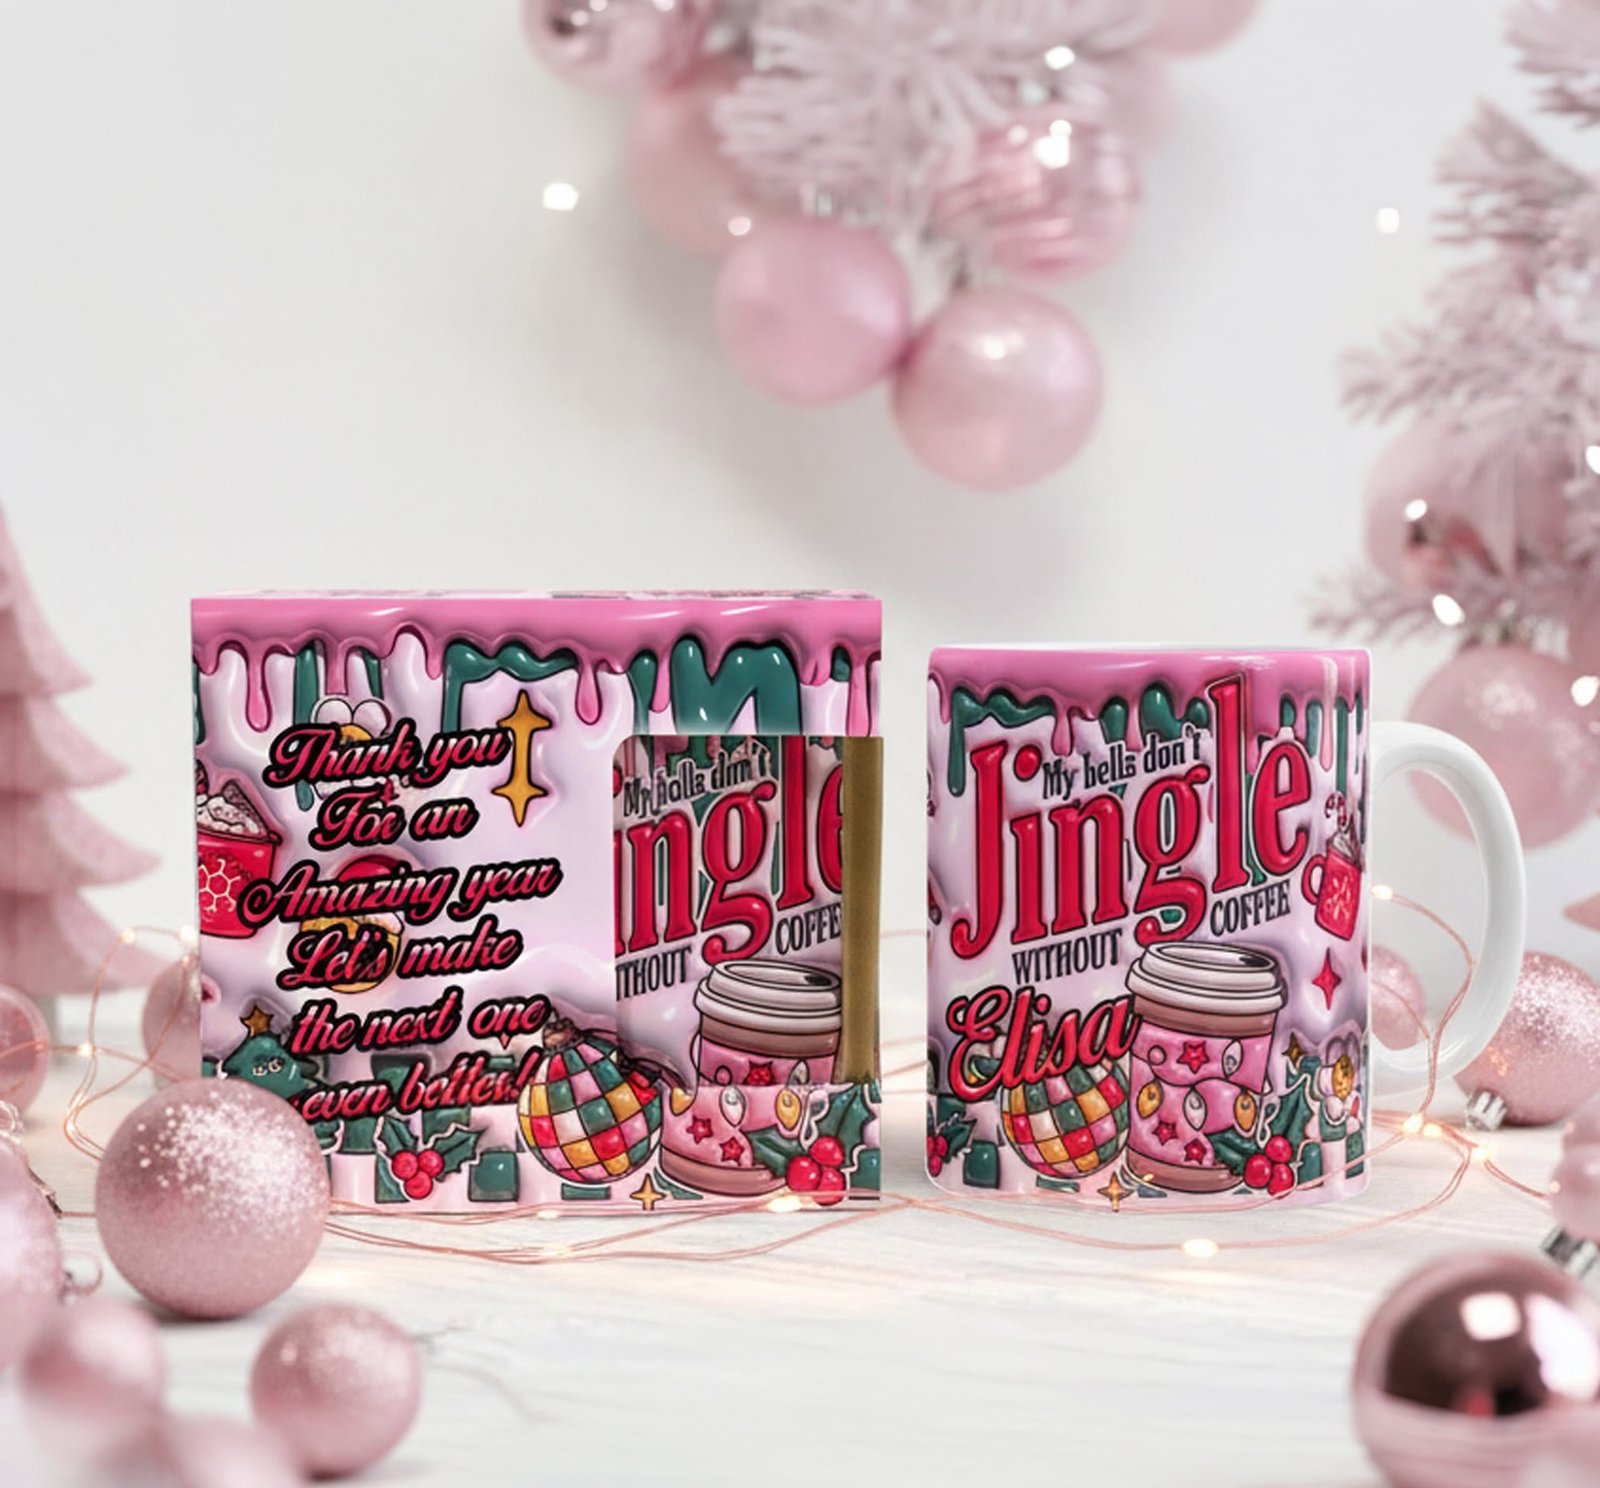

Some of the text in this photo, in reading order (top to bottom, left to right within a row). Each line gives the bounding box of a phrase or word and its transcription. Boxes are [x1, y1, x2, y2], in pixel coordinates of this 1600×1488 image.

[263, 719, 513, 788] Thank you
[1043, 759, 1077, 801] My
[1144, 725, 1202, 773] don't
[409, 797, 479, 842] an
[950, 674, 1311, 960] Jingle
[237, 858, 565, 930] Amazing year
[1012, 879, 1291, 985] WITHOUT COFFEE
[276, 914, 524, 992] Let's make
[615, 903, 842, 1002] ITHOUT COFFE
[289, 985, 550, 1056] the next one
[946, 984, 1142, 1099] Elisa
[298, 1081, 394, 1124] even
